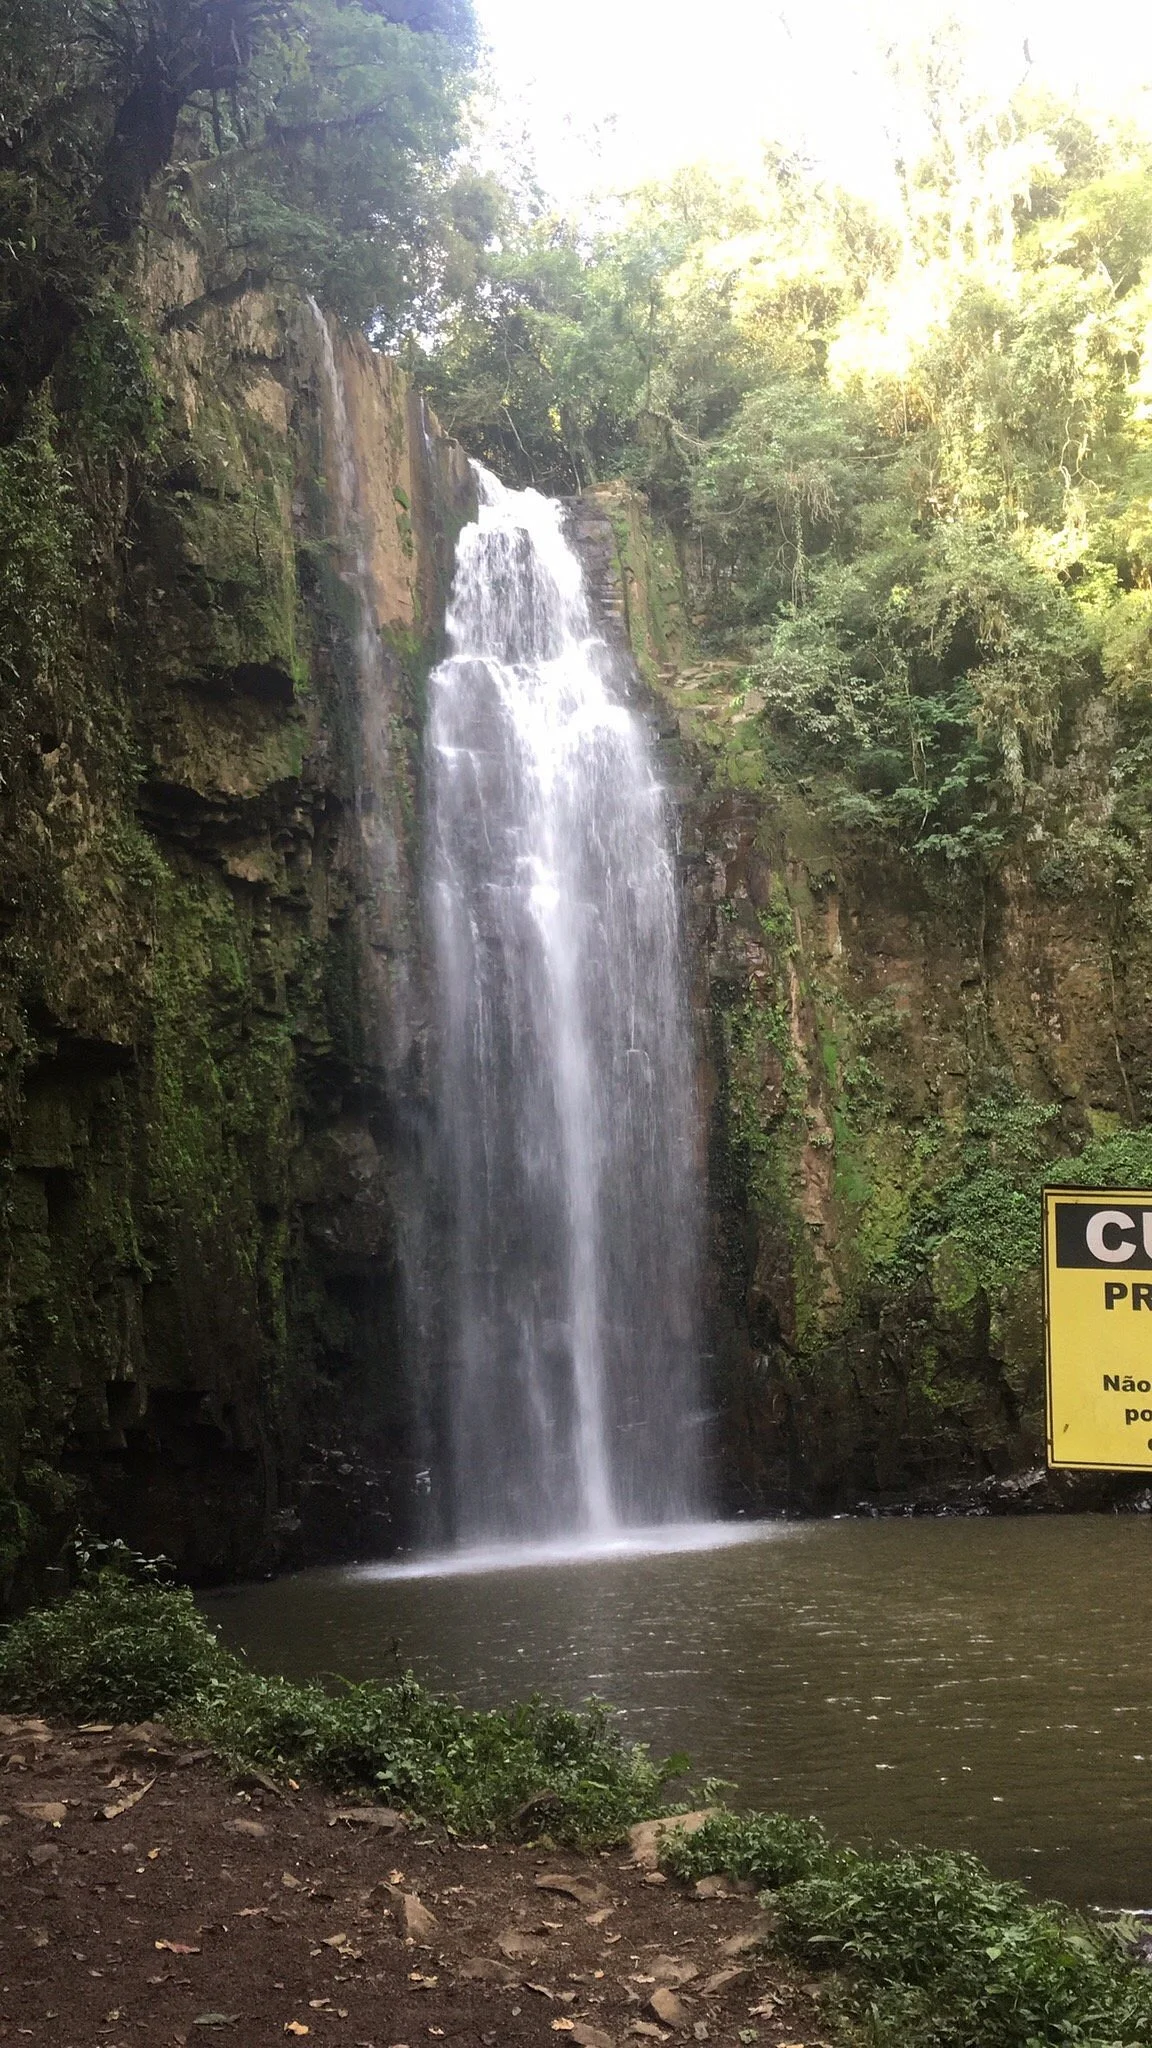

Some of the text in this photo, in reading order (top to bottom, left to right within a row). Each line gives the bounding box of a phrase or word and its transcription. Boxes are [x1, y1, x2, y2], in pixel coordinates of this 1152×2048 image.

[1086, 1210, 1152, 1263] C
[1104, 1282, 1152, 1311] PR
[1103, 1374, 1151, 1392] Não
[1125, 1408, 1152, 1425] po
